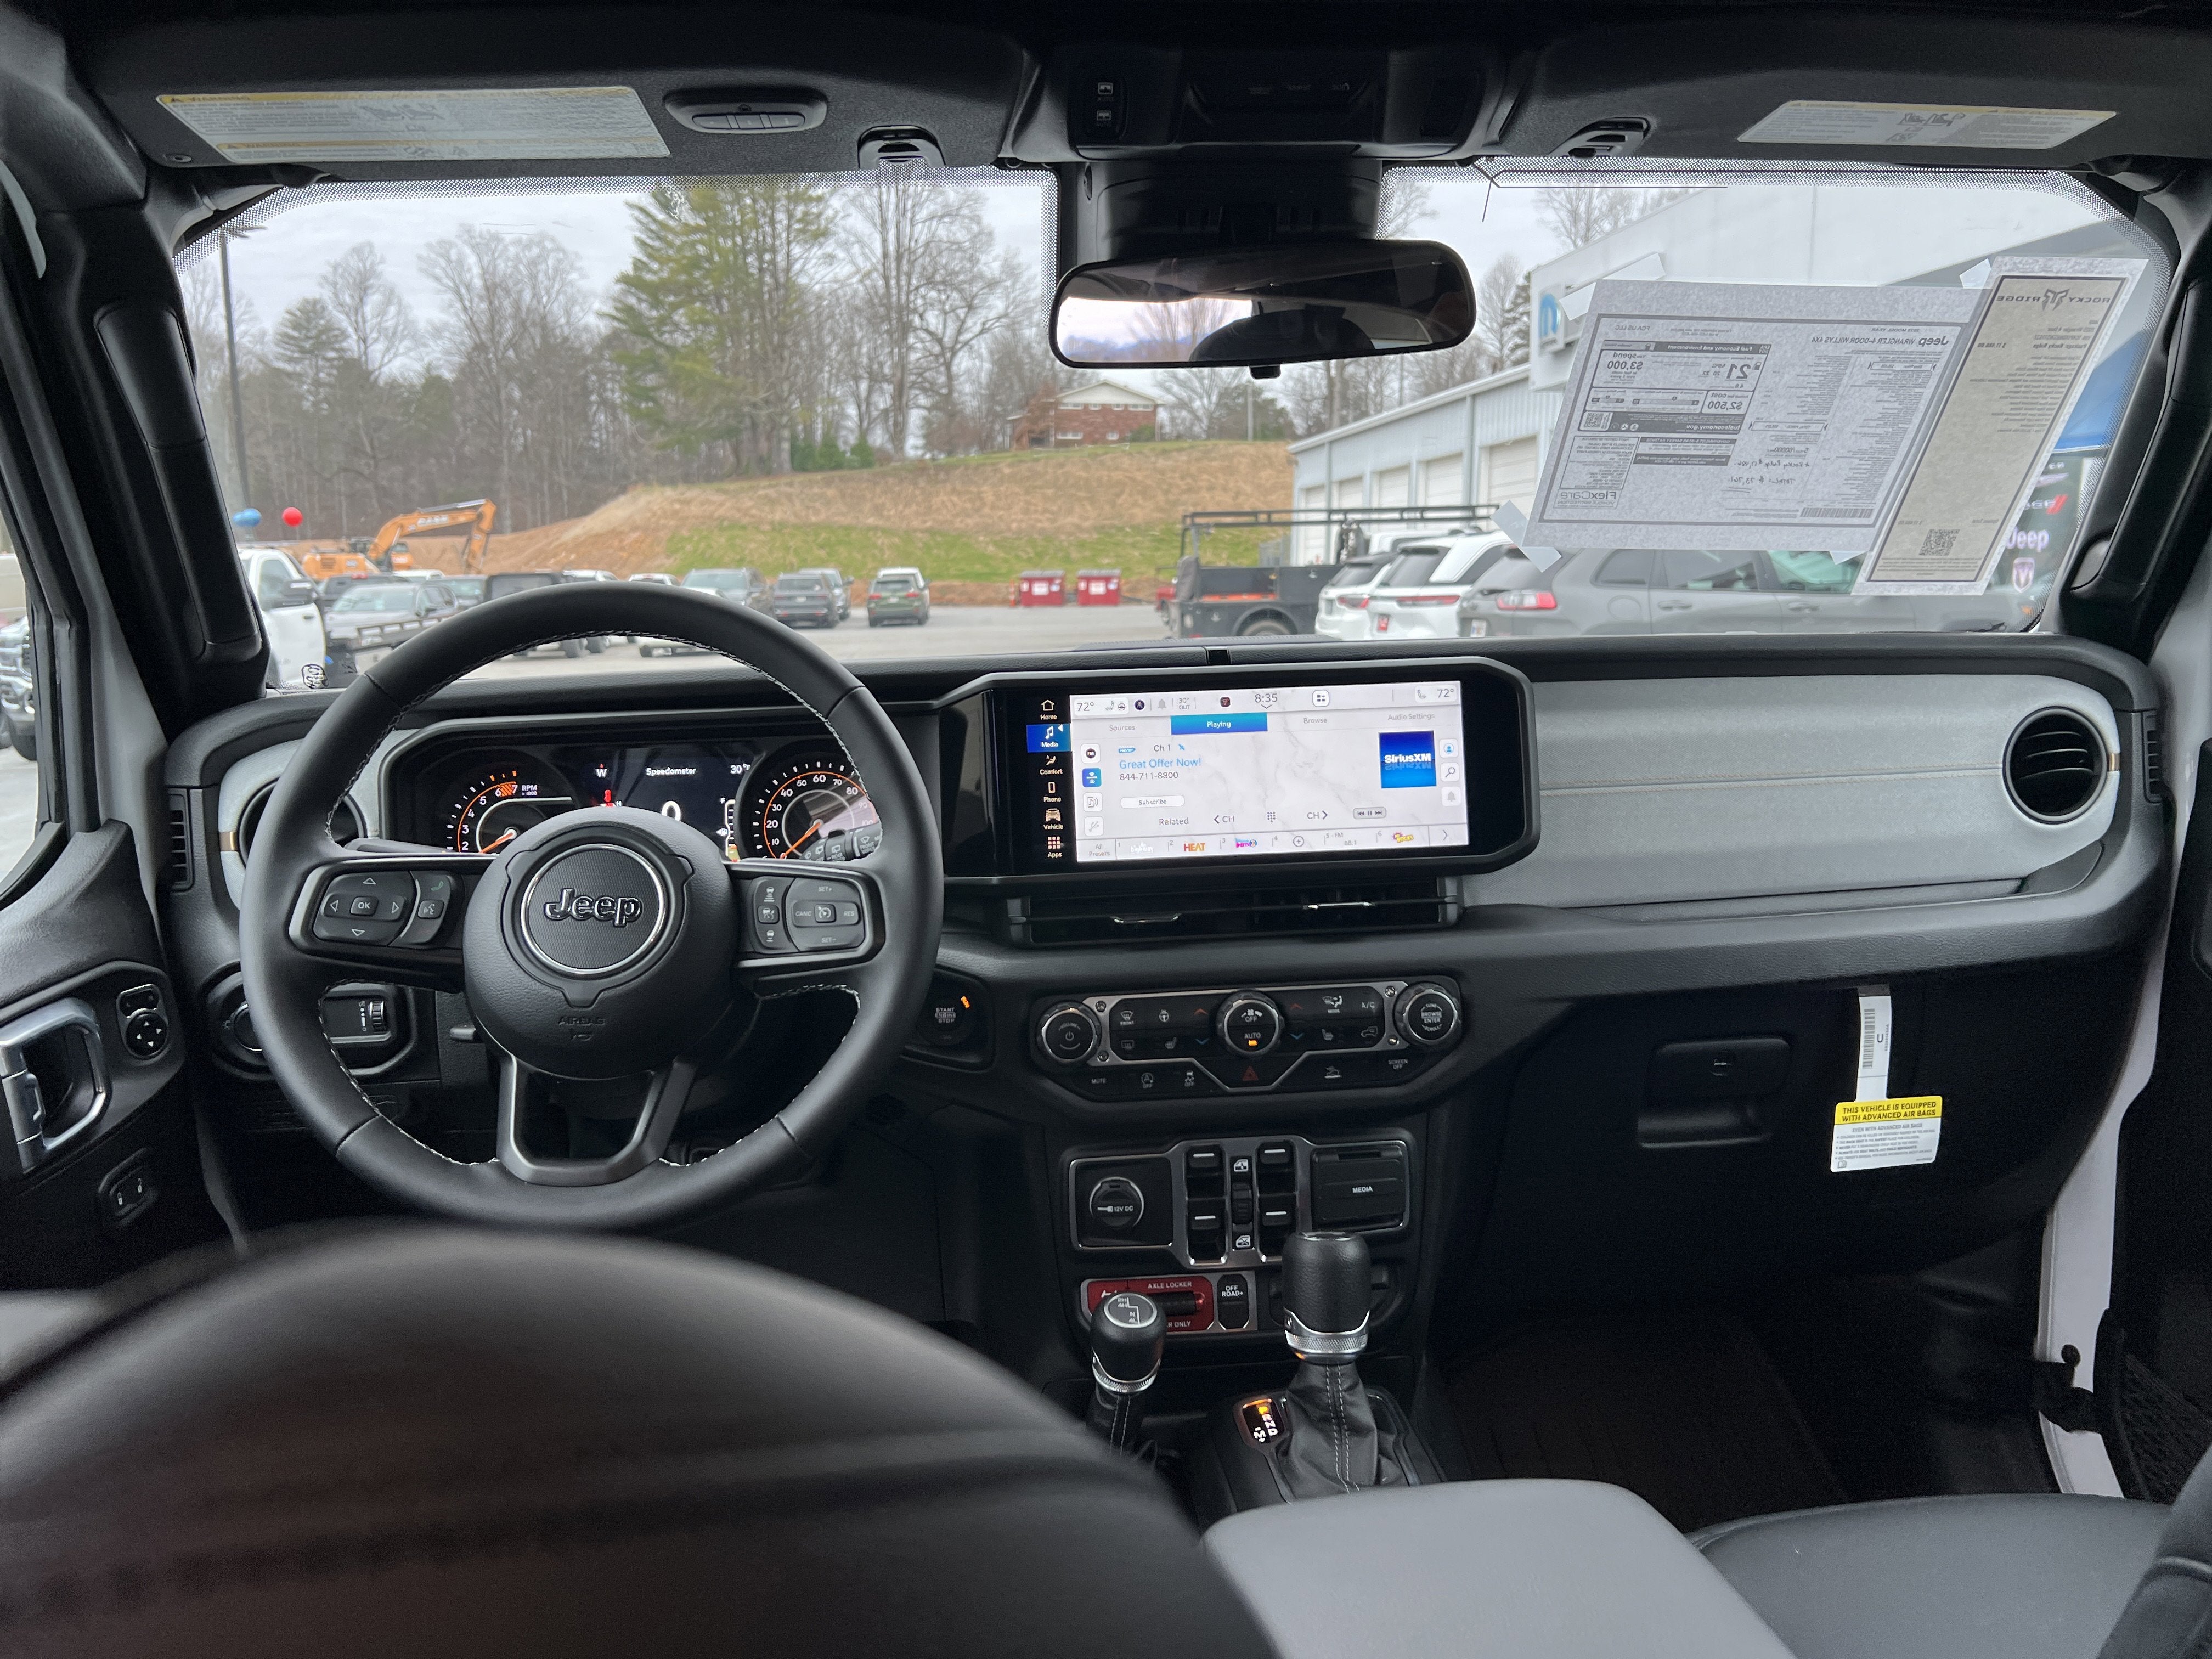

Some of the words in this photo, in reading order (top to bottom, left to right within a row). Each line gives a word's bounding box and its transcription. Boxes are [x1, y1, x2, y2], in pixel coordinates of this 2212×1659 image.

[2005, 525, 2050, 552] Jeep
[1255, 693, 1278, 703] 8:35
[1437, 689, 1454, 698] 72°
[1076, 702, 1094, 712] 72°
[1408, 712, 1435, 721] Settings
[1207, 720, 1231, 729] Playing
[1384, 753, 1431, 763] SiriusXM
[1120, 760, 1146, 769] Great
[1149, 759, 1173, 768] Offer
[1176, 757, 1201, 767] Now!
[596, 768, 607, 777] W
[646, 767, 696, 776] Speedometer
[1120, 772, 1178, 781] 844-711-8800
[495, 788, 501, 797] 6
[511, 785, 518, 793] 7
[781, 788, 793, 797] 40
[846, 787, 858, 795] 80
[479, 796, 487, 805] 5
[468, 809, 475, 818] 4
[766, 820, 778, 828] 20
[1159, 817, 1189, 826] Related
[462, 825, 469, 834] 3
[462, 841, 469, 850] 2
[1183, 843, 1206, 852] HEAT
[545, 888, 644, 927] Jeep
[1877, 1034, 1883, 1043] U
[1901, 1101, 1936, 1109] EQUIPPED
[1842, 1114, 1860, 1122] WITH
[1862, 1111, 1901, 1120] ADVANCED
[1265, 1420, 1276, 1429] N
[1253, 1430, 1266, 1439] M
[1267, 1427, 1278, 1436] D
